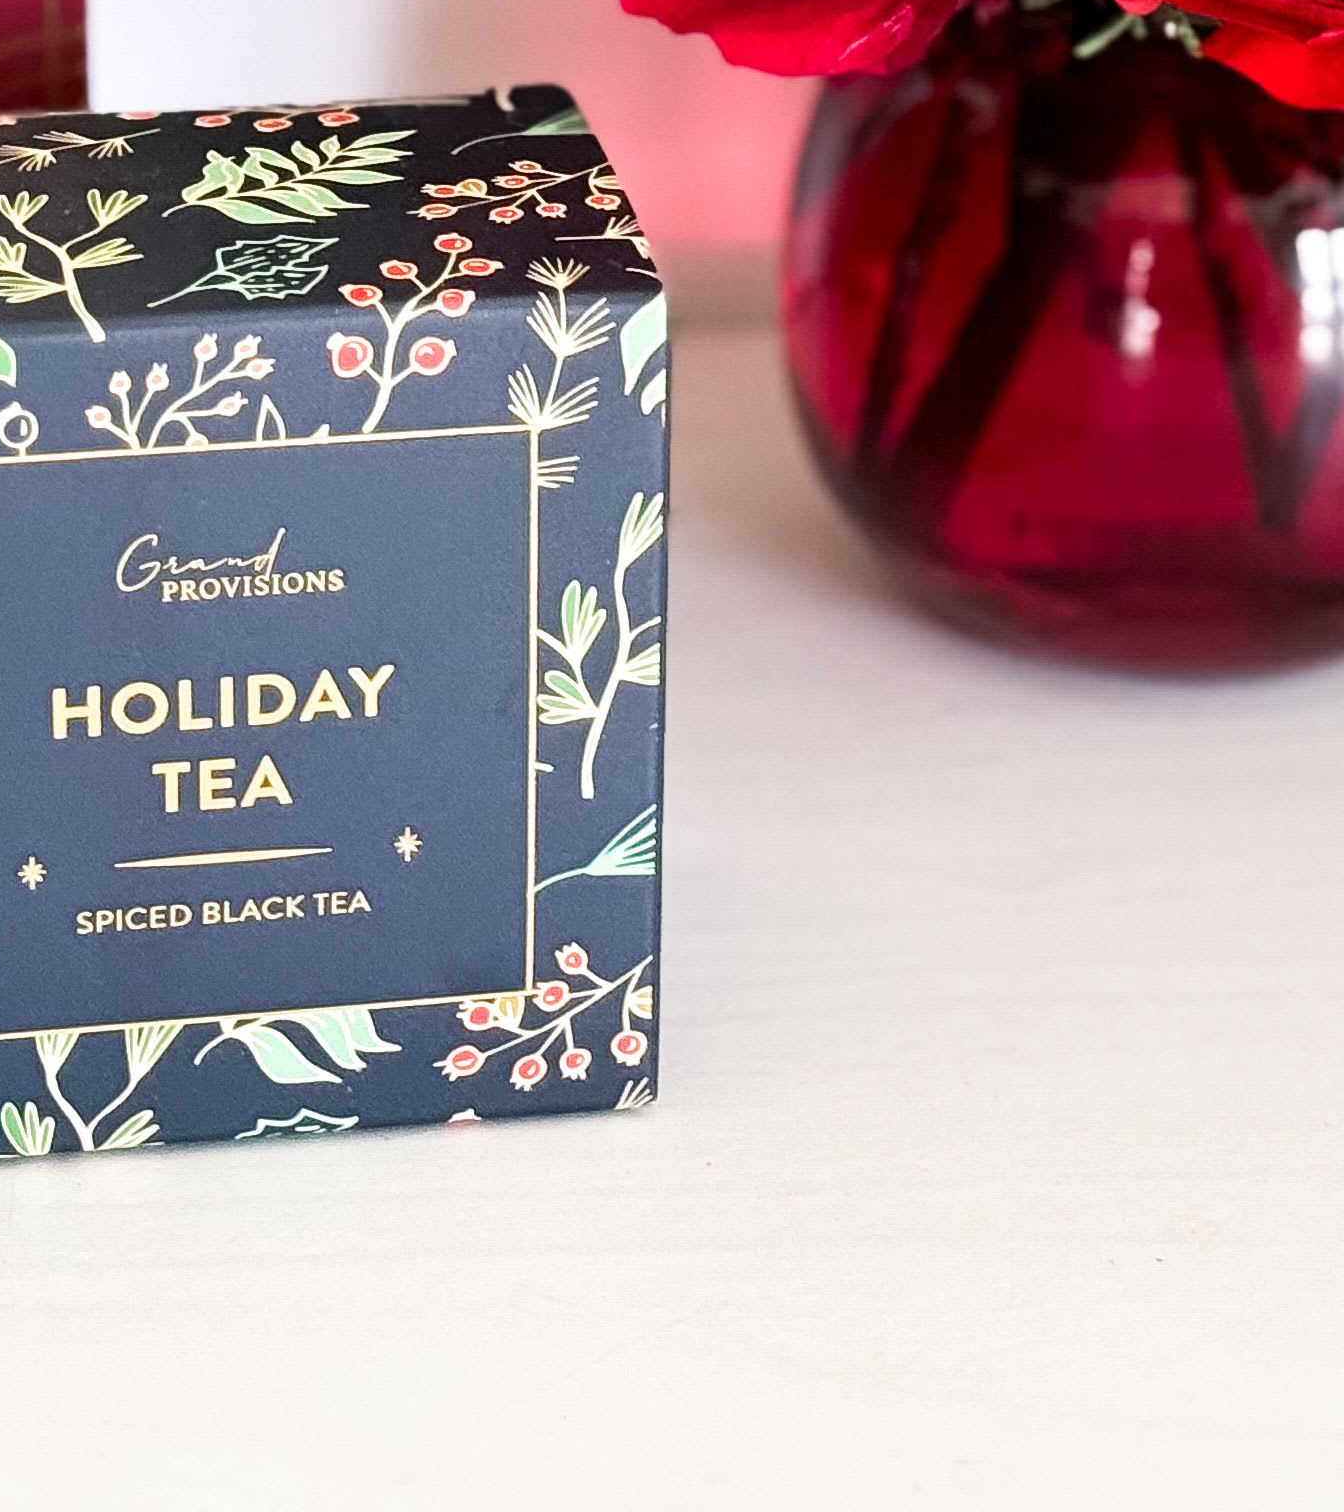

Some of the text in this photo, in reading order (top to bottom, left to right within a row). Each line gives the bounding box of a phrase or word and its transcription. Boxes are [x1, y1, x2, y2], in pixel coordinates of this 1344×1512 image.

[115, 528, 286, 593] Grand
[161, 568, 345, 602] PROVISIONS
[50, 664, 395, 740] HOLIDAY
[152, 755, 293, 813] TEA
[76, 889, 372, 935] SPICED BLACK TEA
